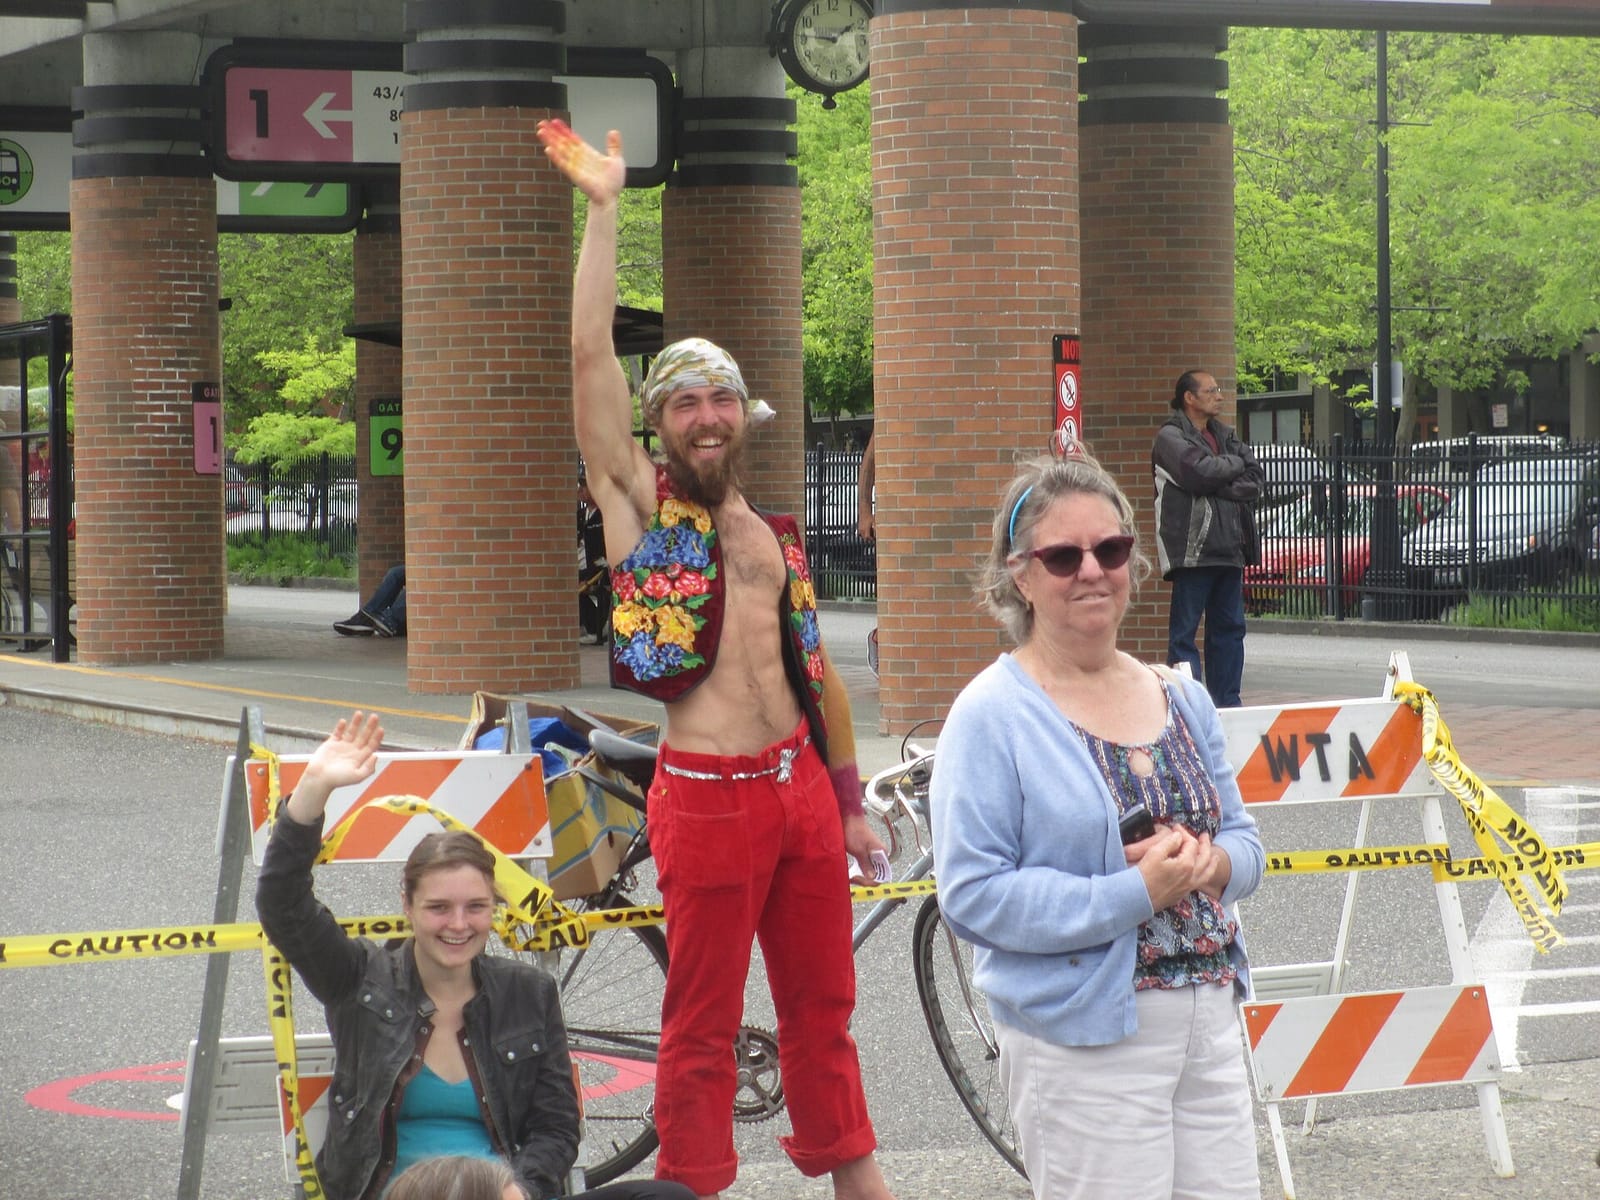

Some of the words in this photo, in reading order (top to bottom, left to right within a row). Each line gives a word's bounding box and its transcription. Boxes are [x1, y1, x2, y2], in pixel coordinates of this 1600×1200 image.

[802, 16, 812, 29] 10
[249, 88, 269, 138] 1
[377, 402, 401, 413] GAT
[380, 427, 404, 461] 9
[1260, 732, 1376, 783] WTA
[48, 930, 217, 958] CAUTION
